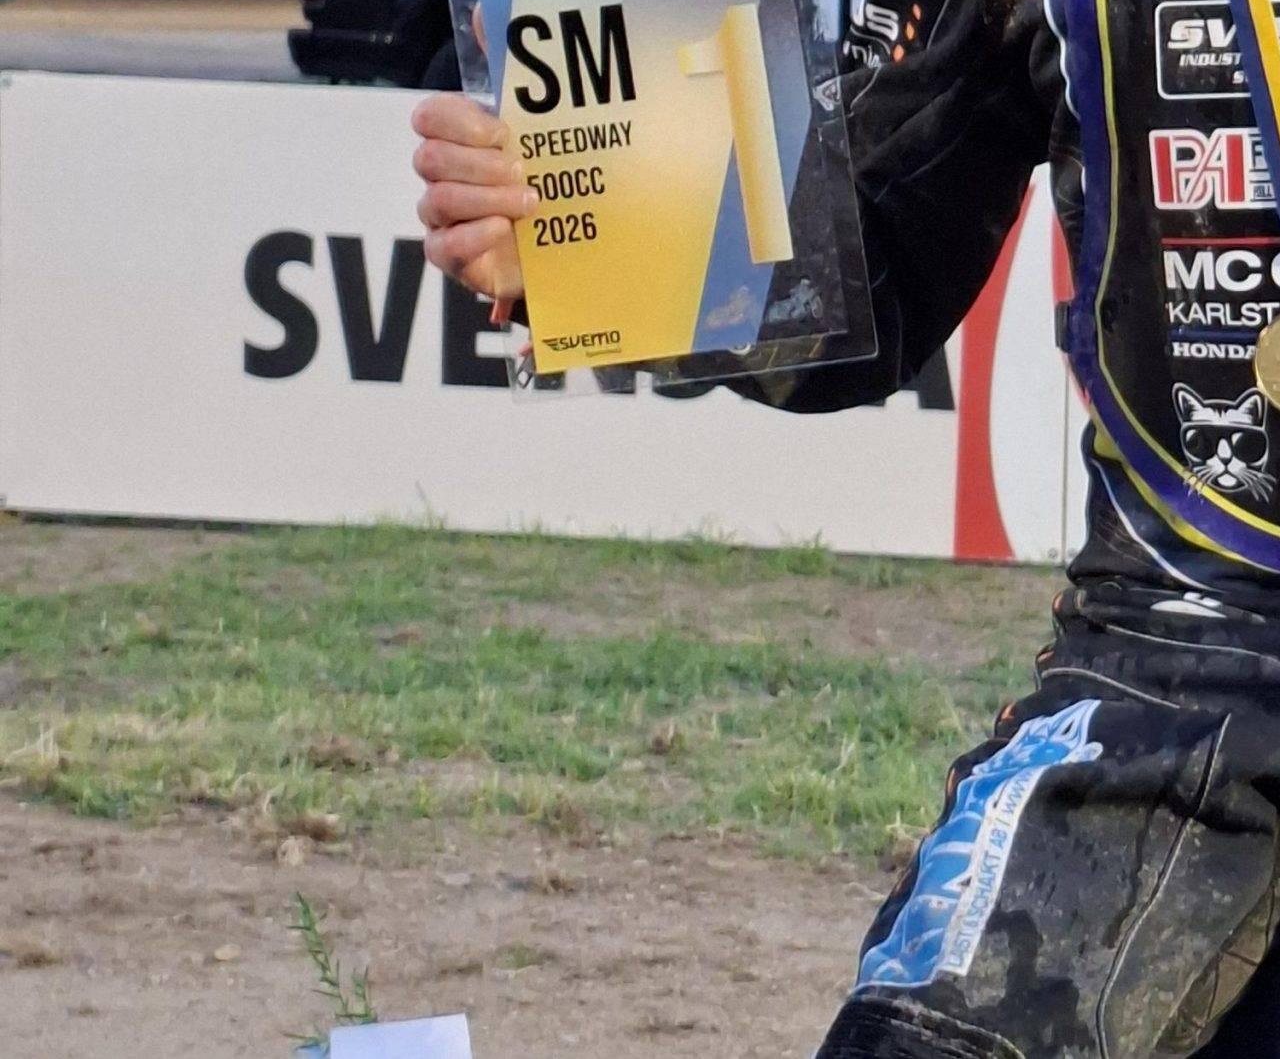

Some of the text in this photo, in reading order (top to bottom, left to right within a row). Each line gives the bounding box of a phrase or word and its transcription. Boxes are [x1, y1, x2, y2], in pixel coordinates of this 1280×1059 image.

[506, 4, 637, 114] SM
[519, 121, 633, 160] SPEEDWAY
[527, 166, 606, 203] 500CC
[533, 212, 598, 247] 2026
[1163, 250, 1263, 292] MC
